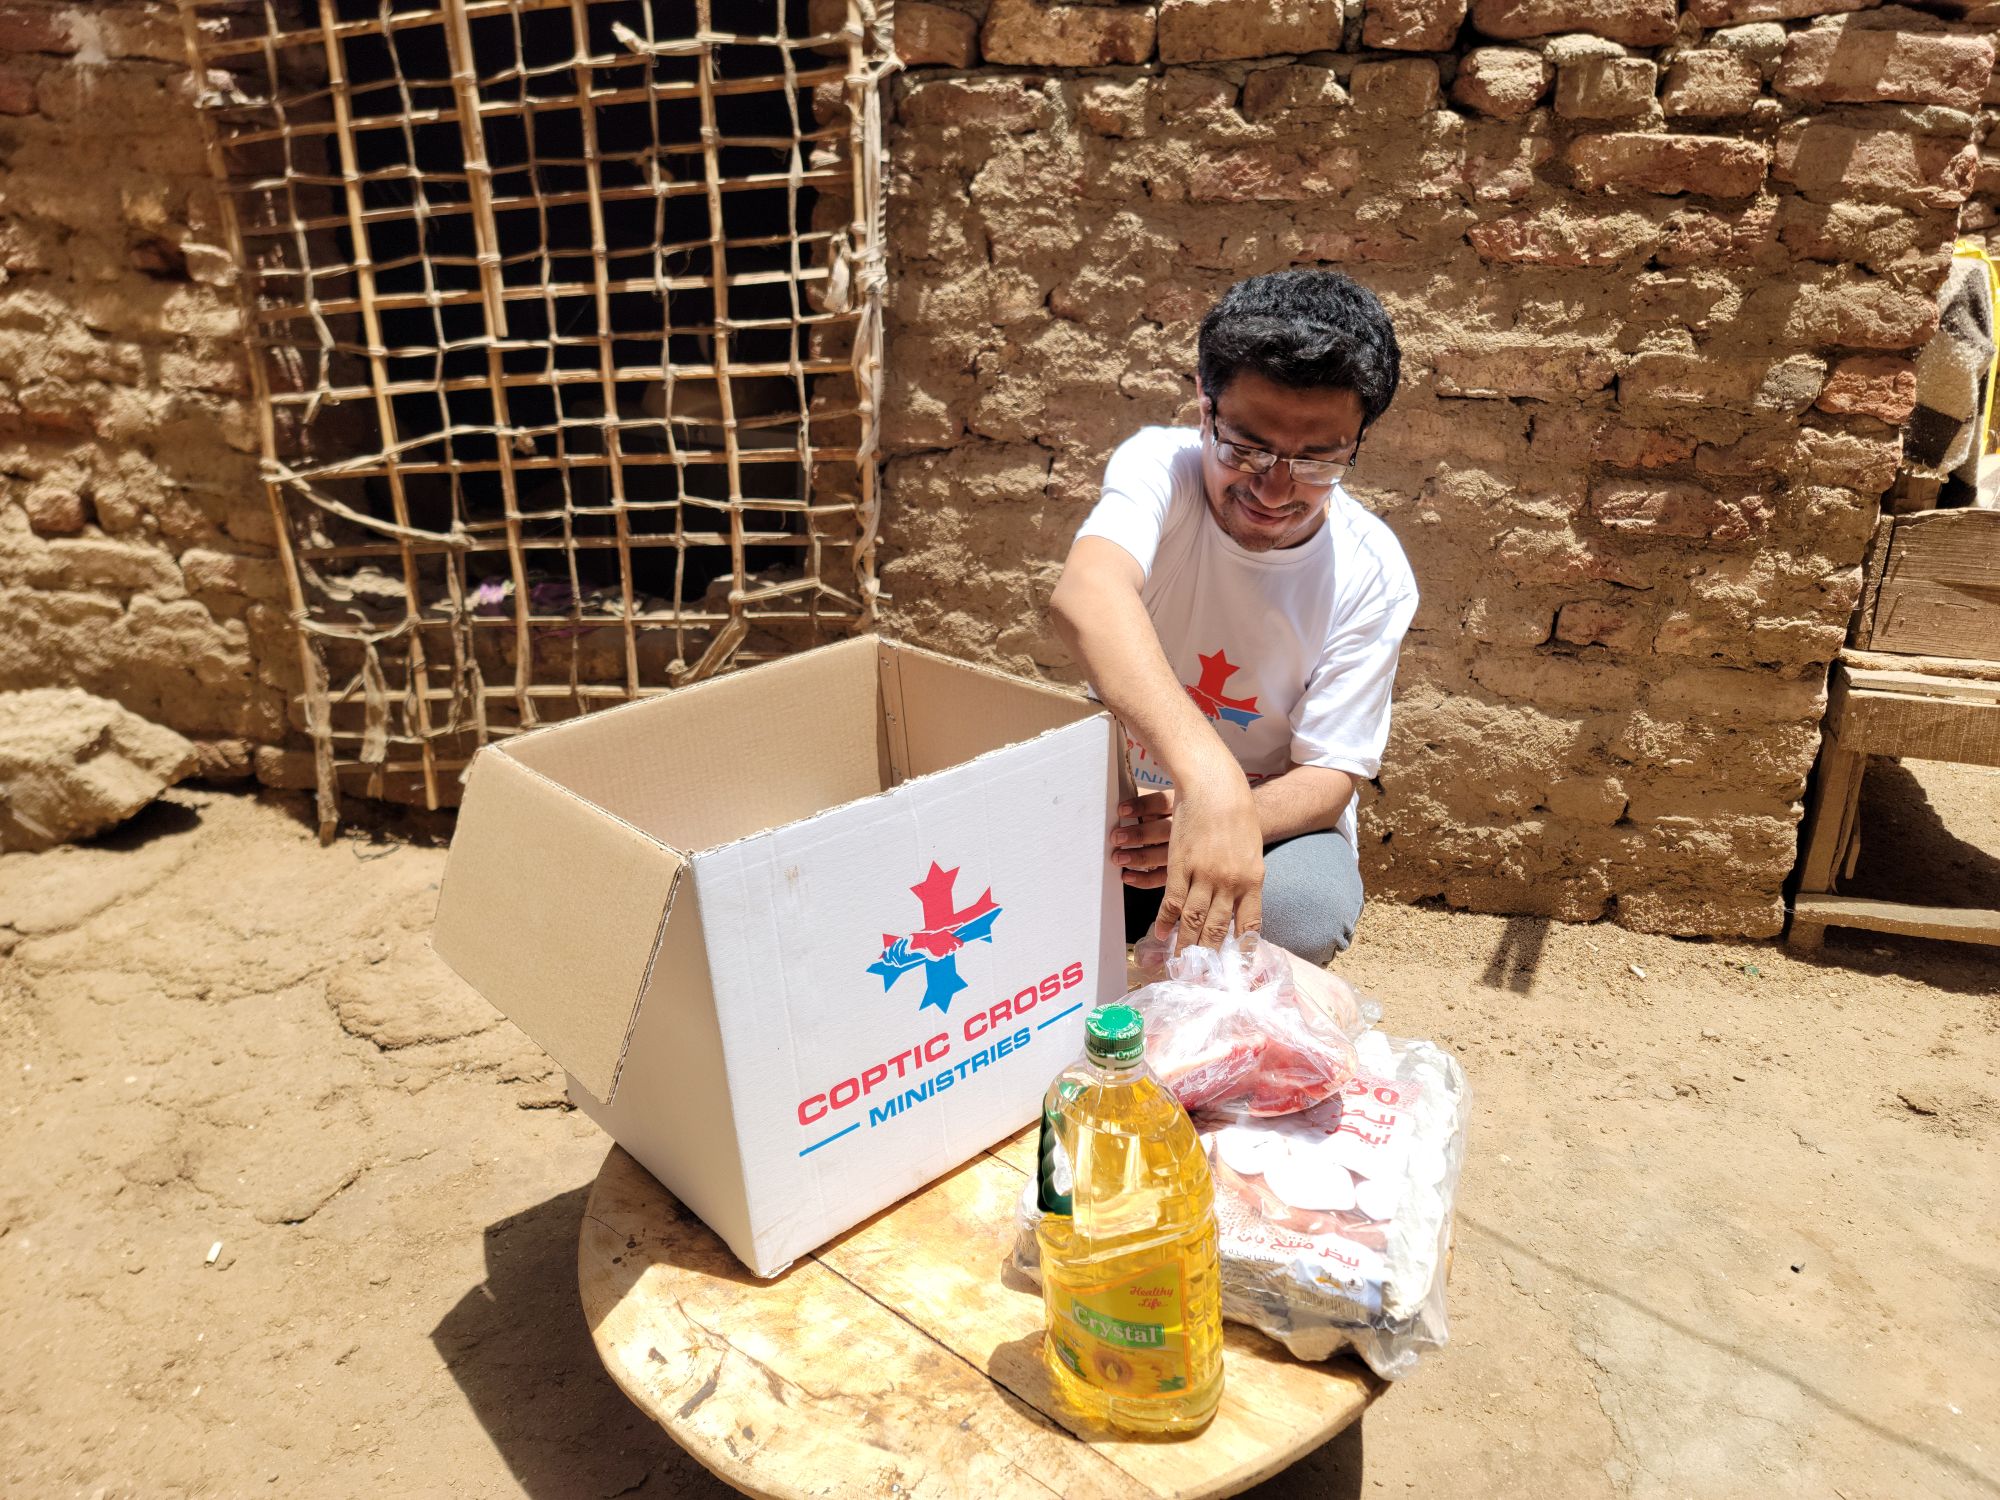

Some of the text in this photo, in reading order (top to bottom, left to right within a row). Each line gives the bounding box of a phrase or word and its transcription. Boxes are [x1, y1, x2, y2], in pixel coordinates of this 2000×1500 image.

[797, 961, 1084, 1126] COPTIC CROSS
[868, 1027, 1031, 1128] MINISTRIES
[1129, 1285, 1174, 1298] Healthy
[1138, 1297, 1165, 1310] Life
[1074, 1305, 1158, 1344] Crystal
